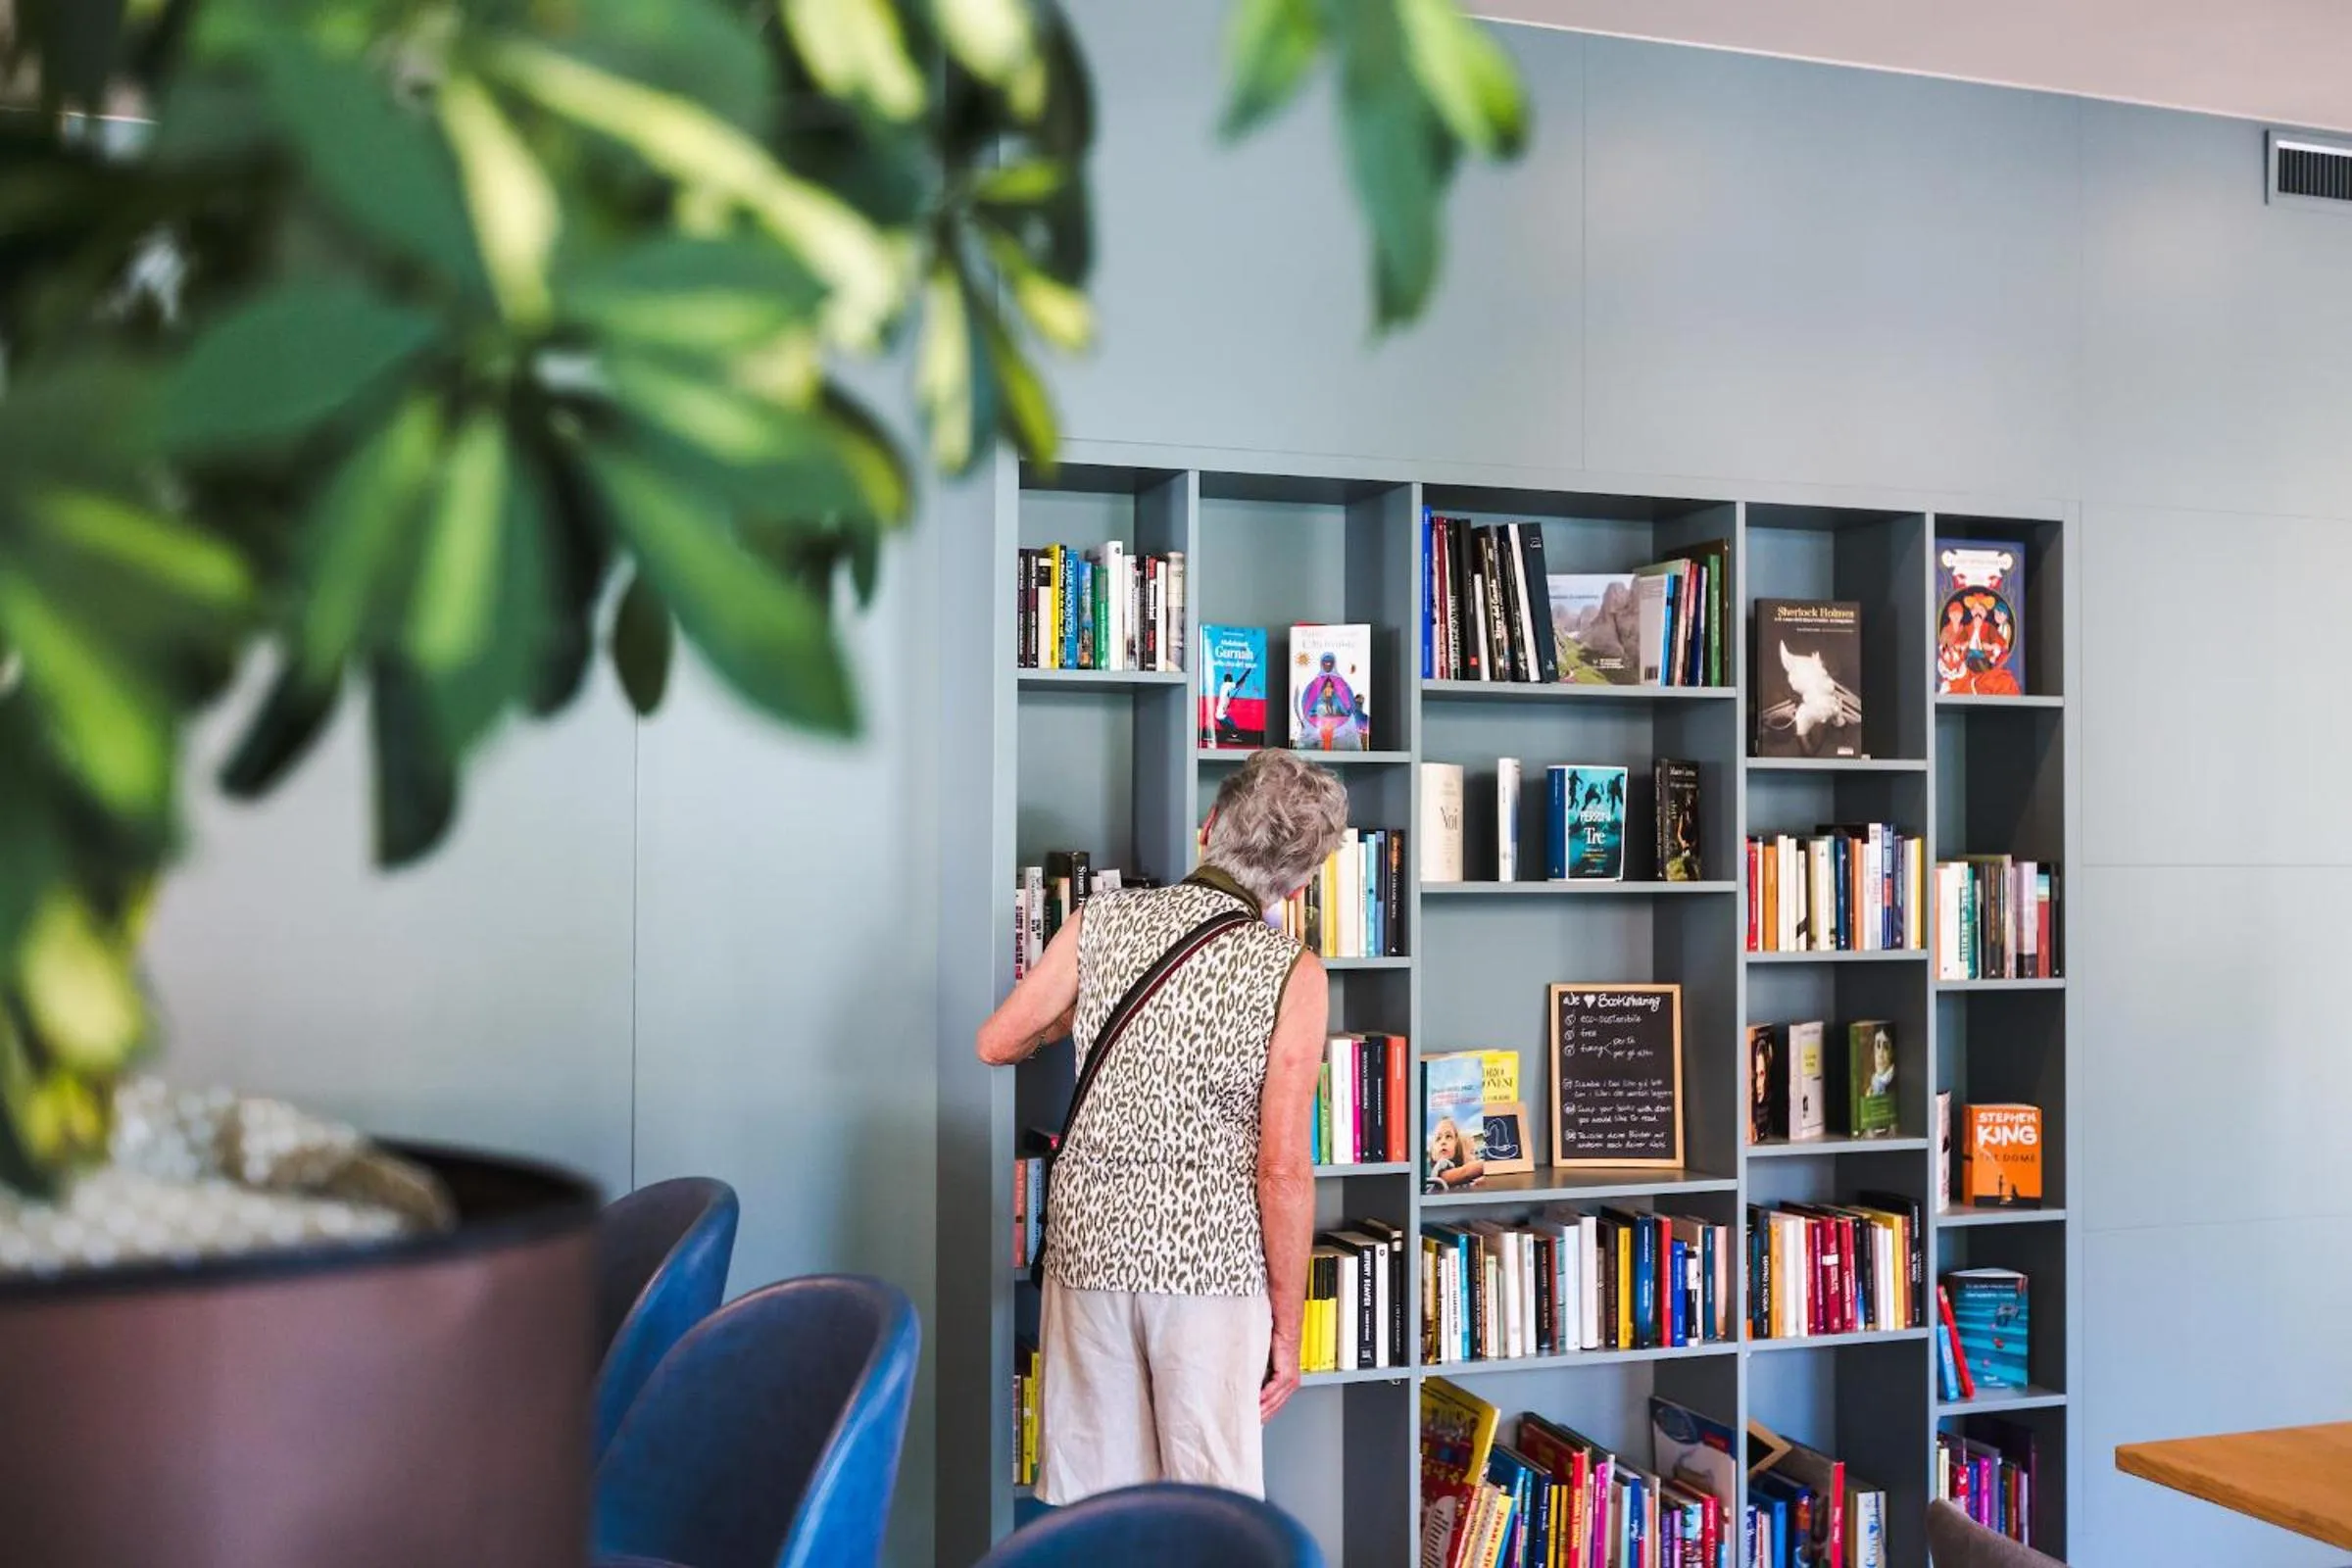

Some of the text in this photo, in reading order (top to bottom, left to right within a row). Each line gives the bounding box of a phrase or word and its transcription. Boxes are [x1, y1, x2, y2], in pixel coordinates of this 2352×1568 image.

[1777, 606, 1854, 618] Sherlock Holmes
[1215, 646, 1253, 659] Gurnah
[1584, 827, 1606, 845] Tre
[1978, 1112, 2036, 1123] STEPHEN
[1977, 1125, 2037, 1147] KING
[2002, 1152, 2035, 1162] DOME
